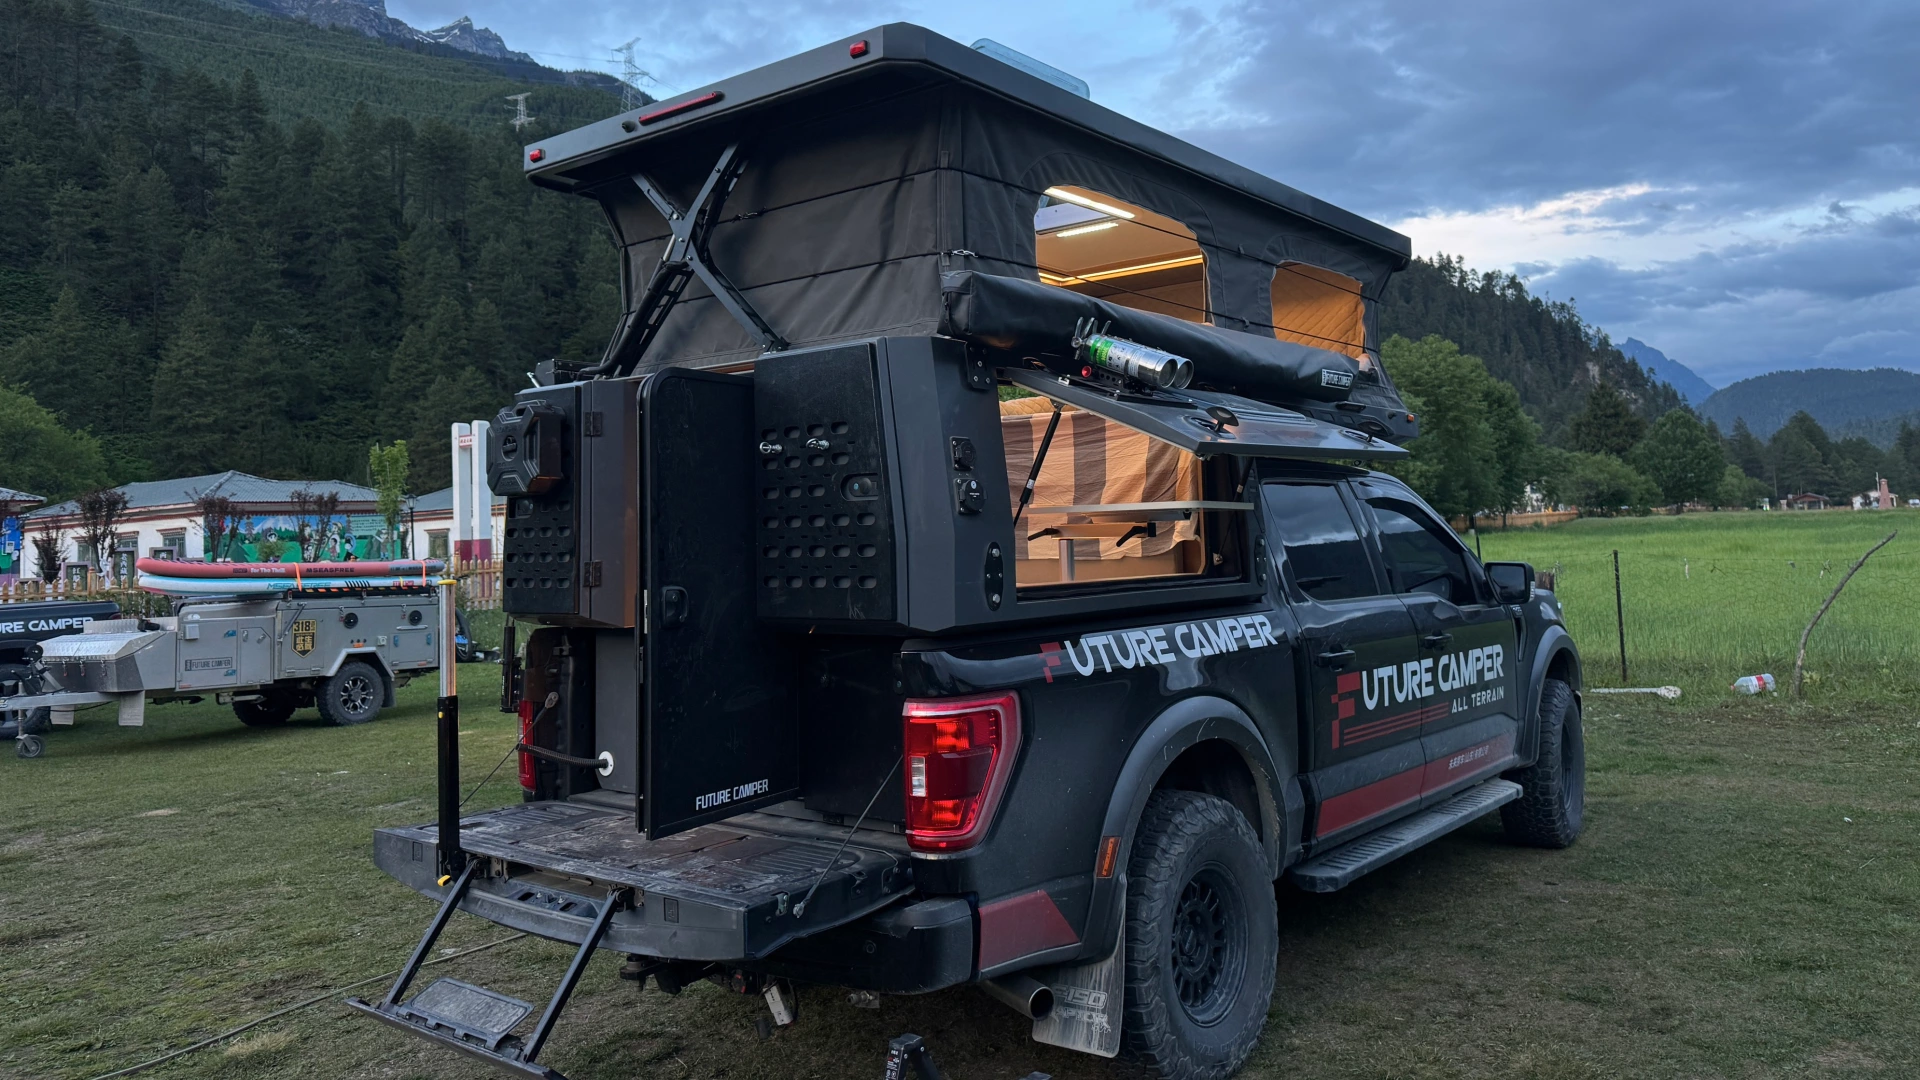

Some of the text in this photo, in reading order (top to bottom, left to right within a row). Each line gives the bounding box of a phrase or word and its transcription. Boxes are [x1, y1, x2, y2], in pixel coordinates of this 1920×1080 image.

[293, 620, 311, 632] 318
[1038, 614, 1278, 683] FUTURE CAMPER
[1331, 644, 1504, 749] FUTURE CAMPER
[1451, 686, 1505, 714] ALL TERRAIN
[695, 778, 769, 811] FUTURE CAMPER
